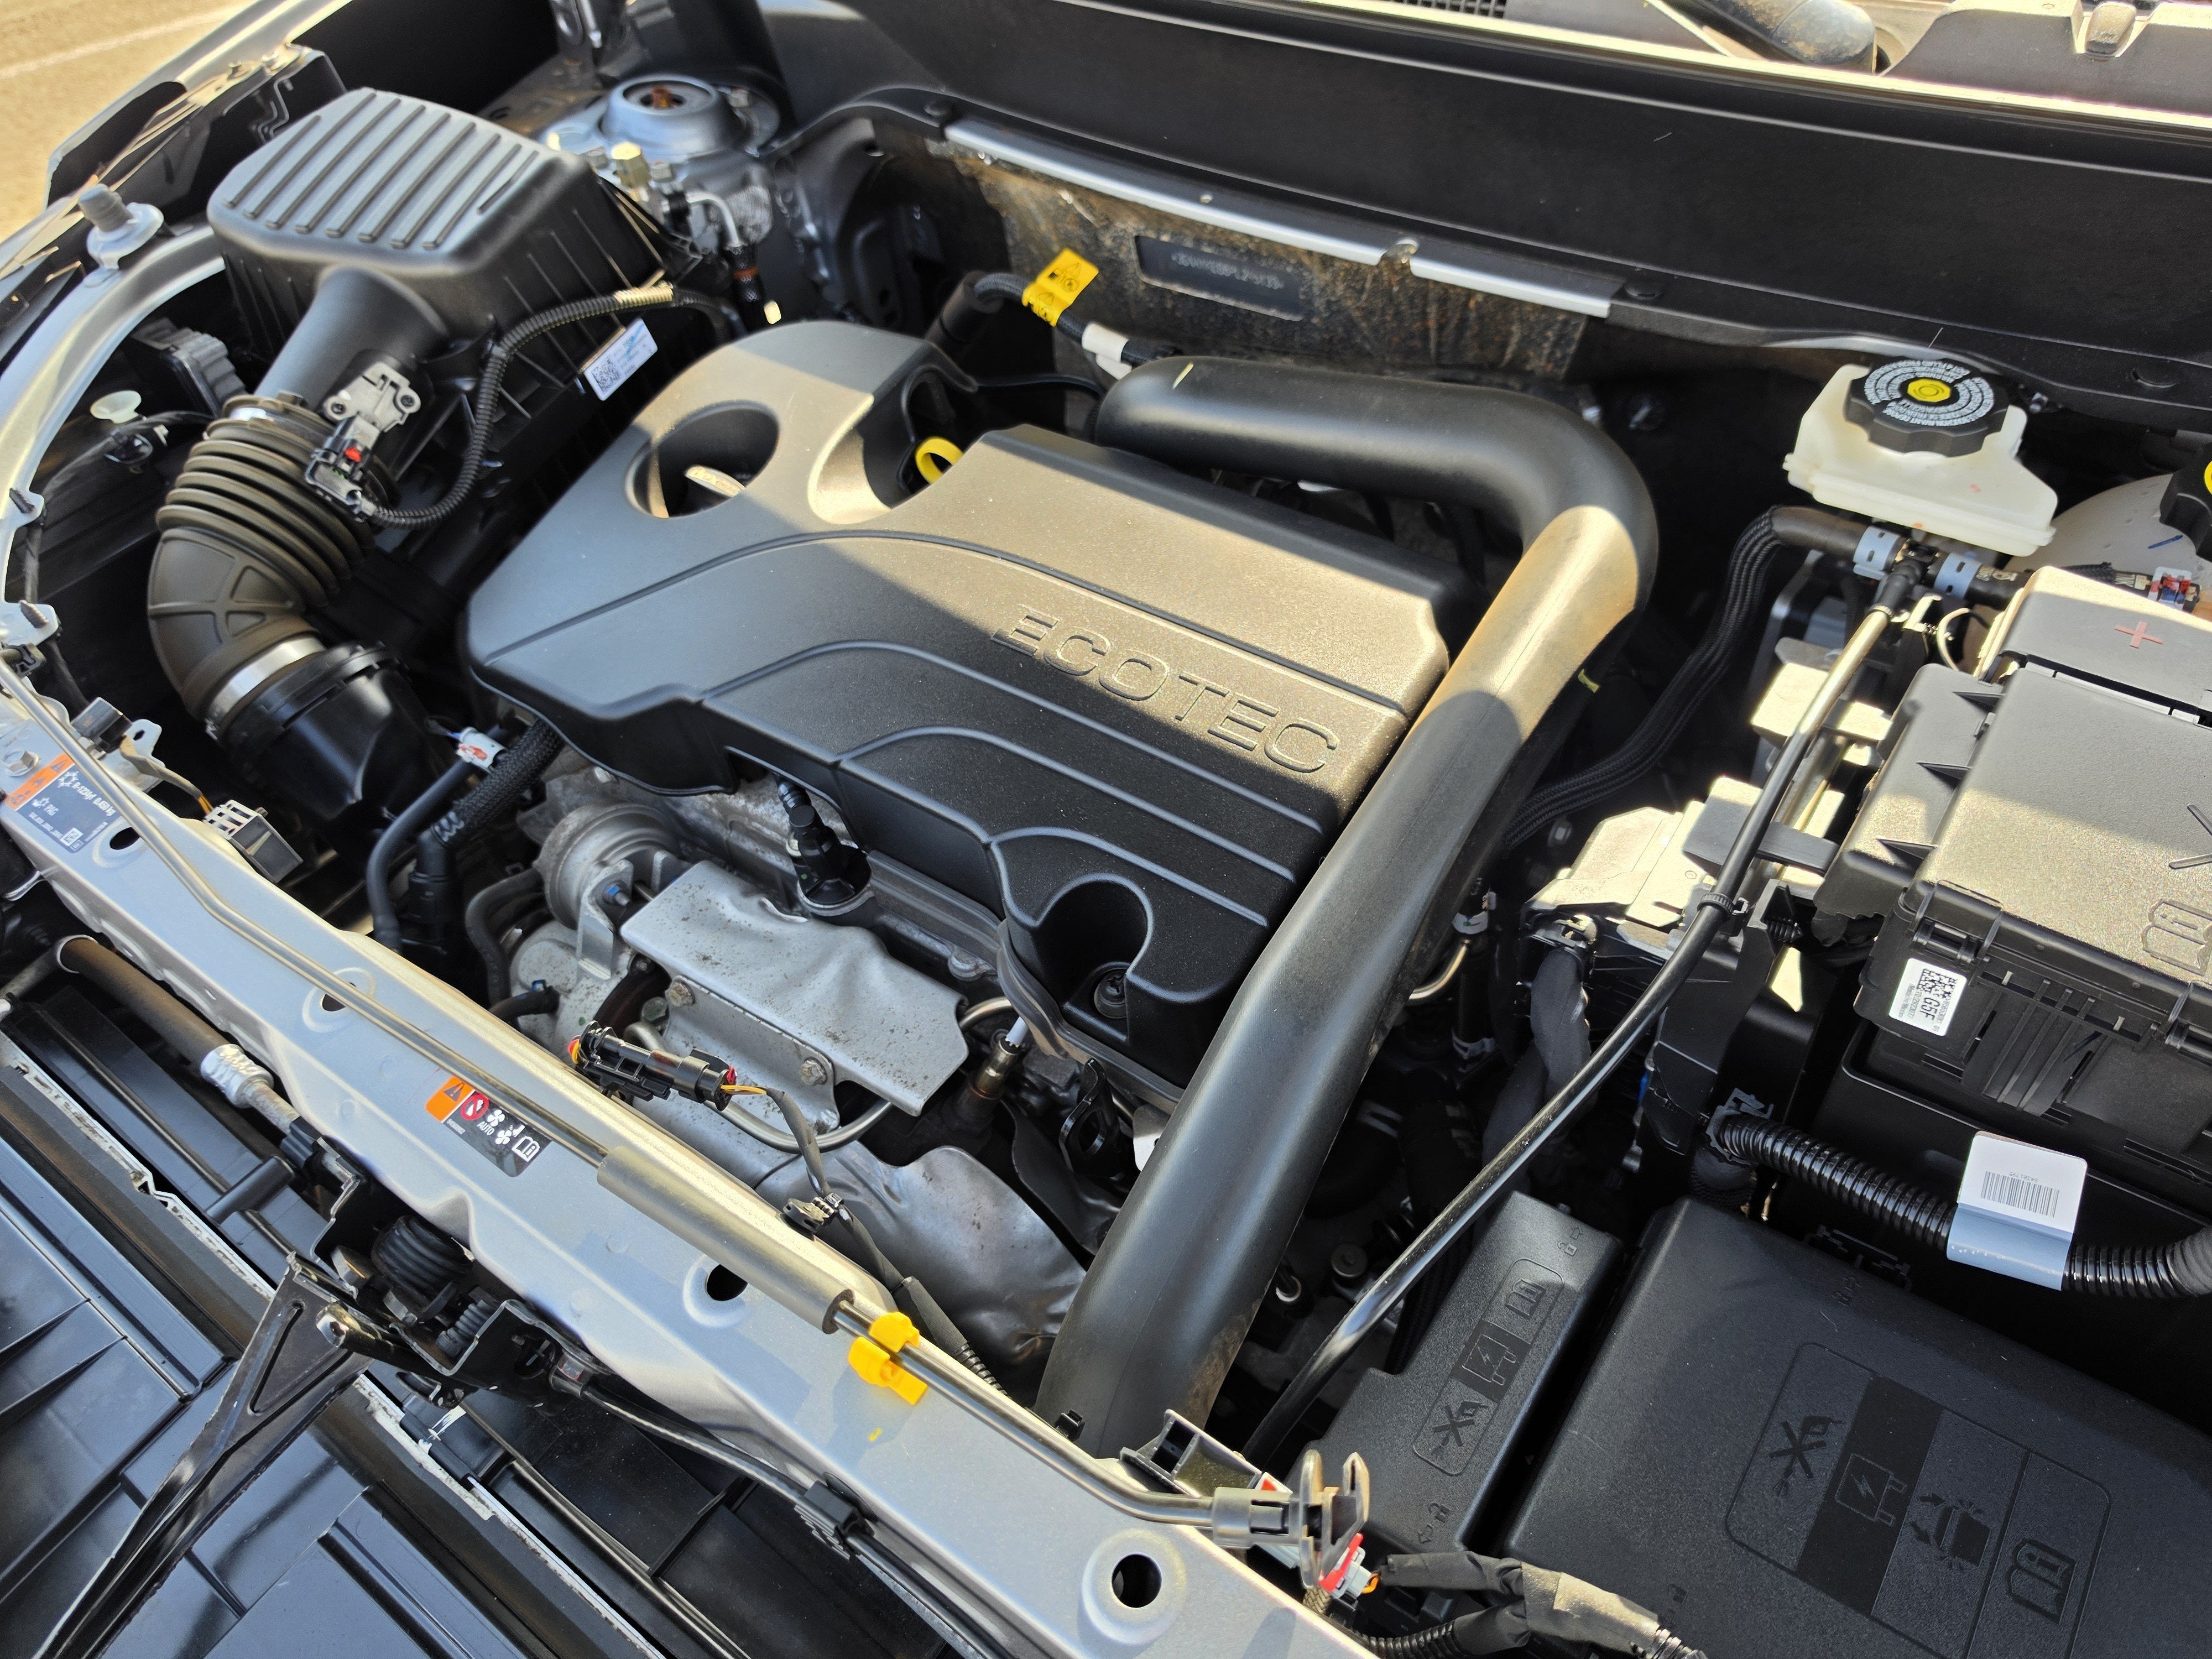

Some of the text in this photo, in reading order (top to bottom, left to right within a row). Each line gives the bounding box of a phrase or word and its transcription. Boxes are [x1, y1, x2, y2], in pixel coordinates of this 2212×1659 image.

[990, 603, 1339, 773] ECOTEC
[44, 803, 59, 816] PAG
[1919, 998, 1940, 1020] G5F
[477, 1121, 495, 1135] AUTO
